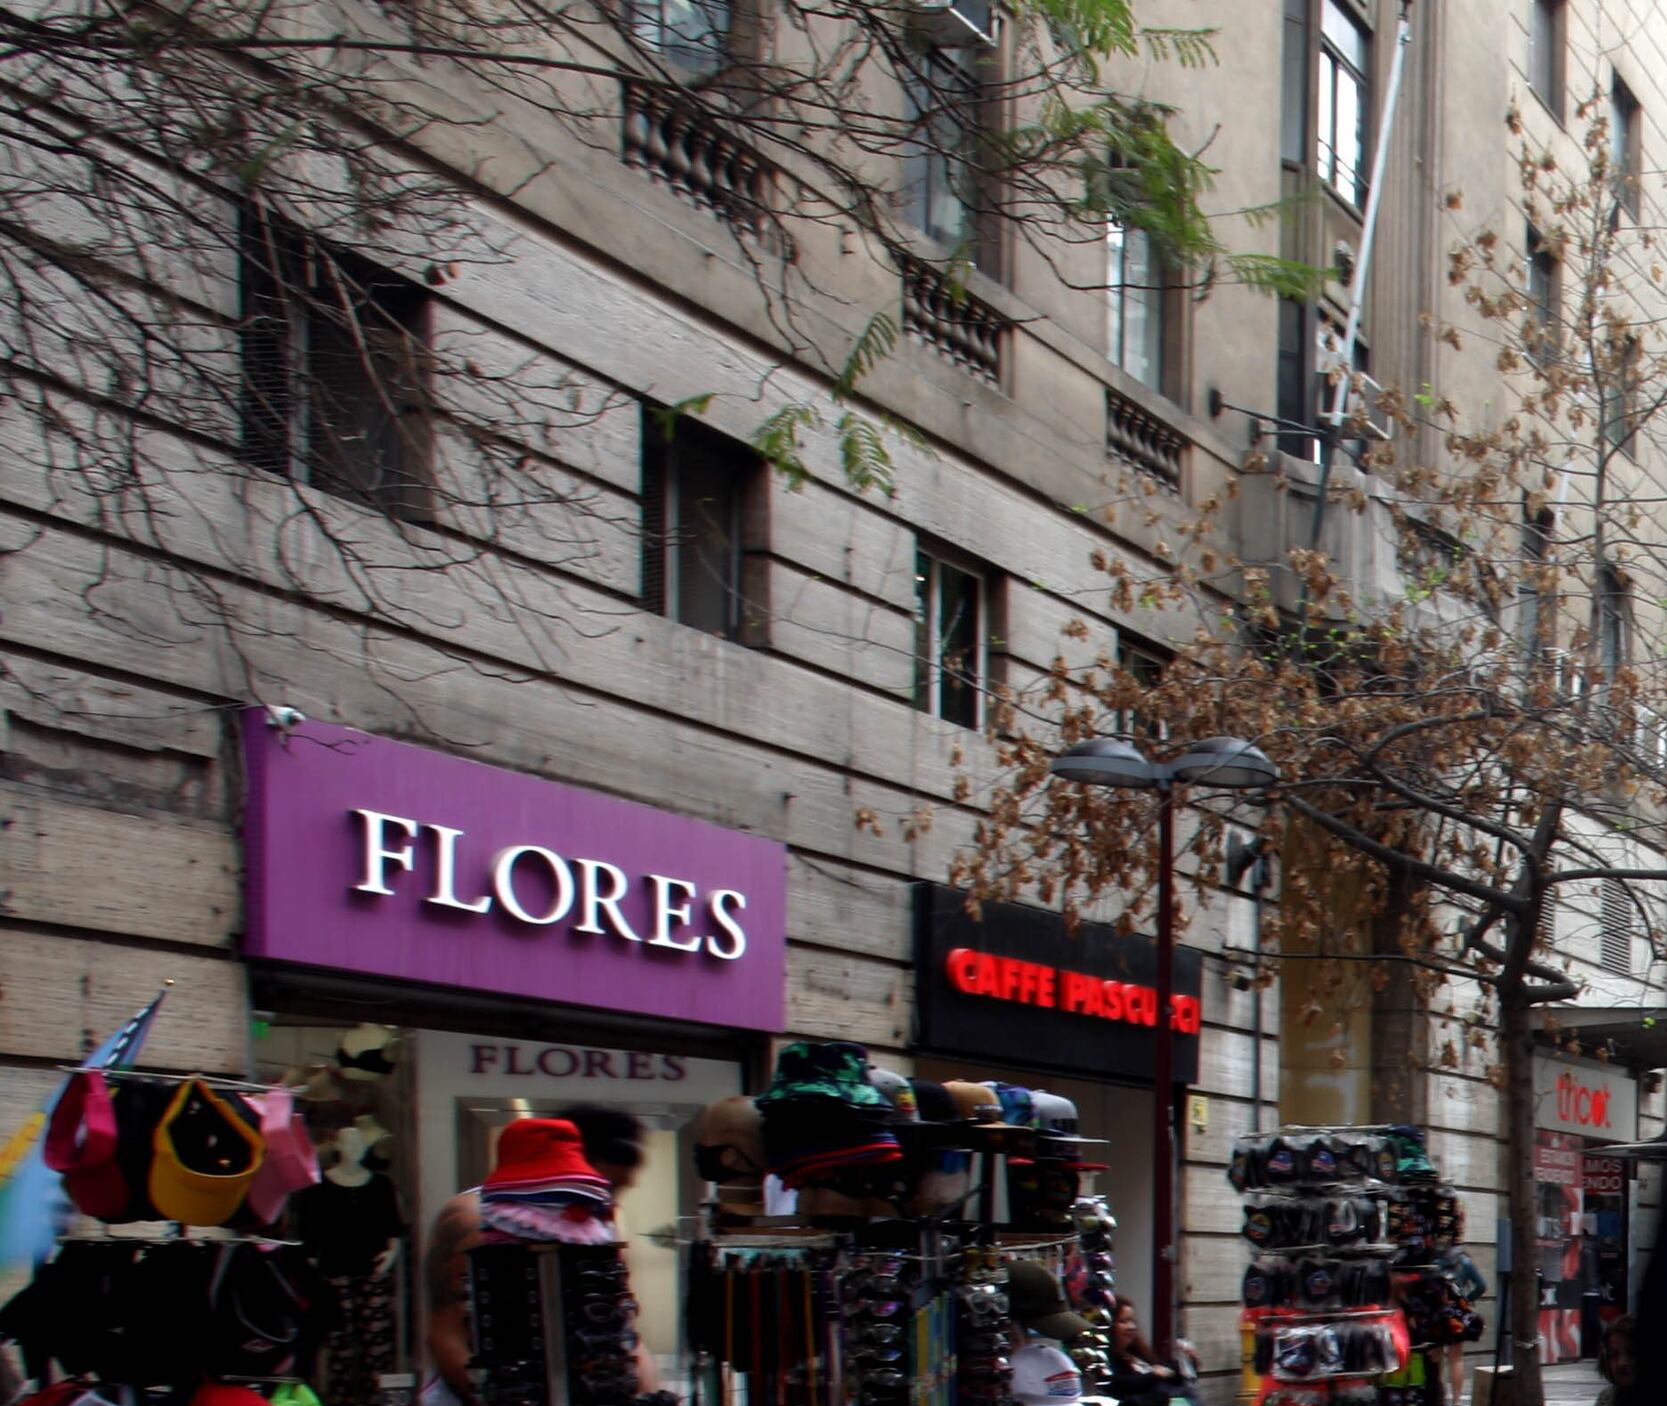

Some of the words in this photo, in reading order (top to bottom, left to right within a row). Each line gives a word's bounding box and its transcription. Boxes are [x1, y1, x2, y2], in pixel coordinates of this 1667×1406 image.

[352, 808, 747, 961] FLORES
[946, 948, 1057, 1008] CAFFE
[469, 1045, 687, 1082] FLORES
